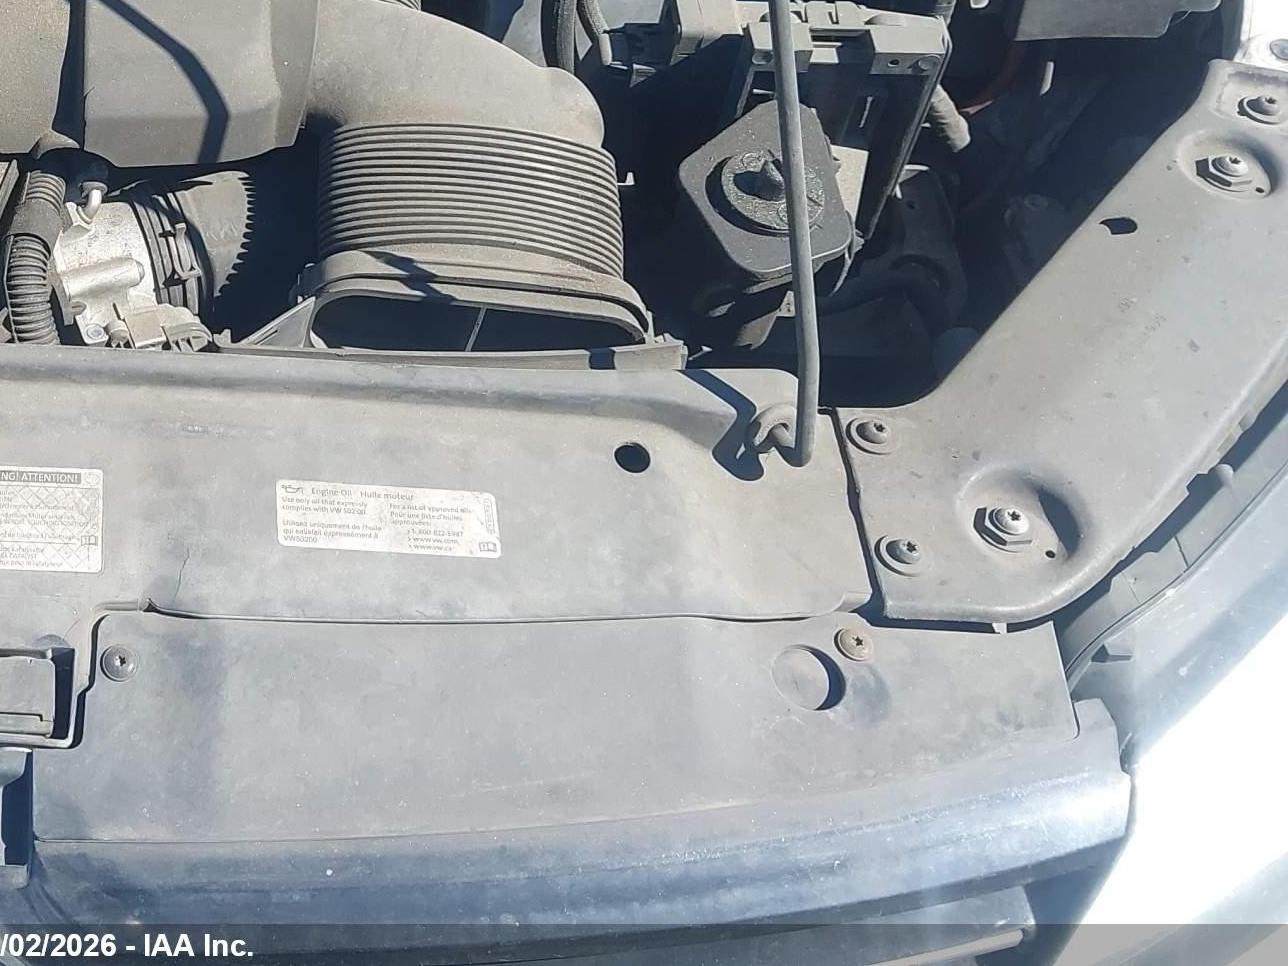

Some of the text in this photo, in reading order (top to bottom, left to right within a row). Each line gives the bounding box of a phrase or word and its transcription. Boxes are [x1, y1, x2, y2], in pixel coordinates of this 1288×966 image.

[21, 473, 79, 483] ATTENTION!
[311, 487, 339, 497] Engine
[383, 492, 414, 501] moteur
